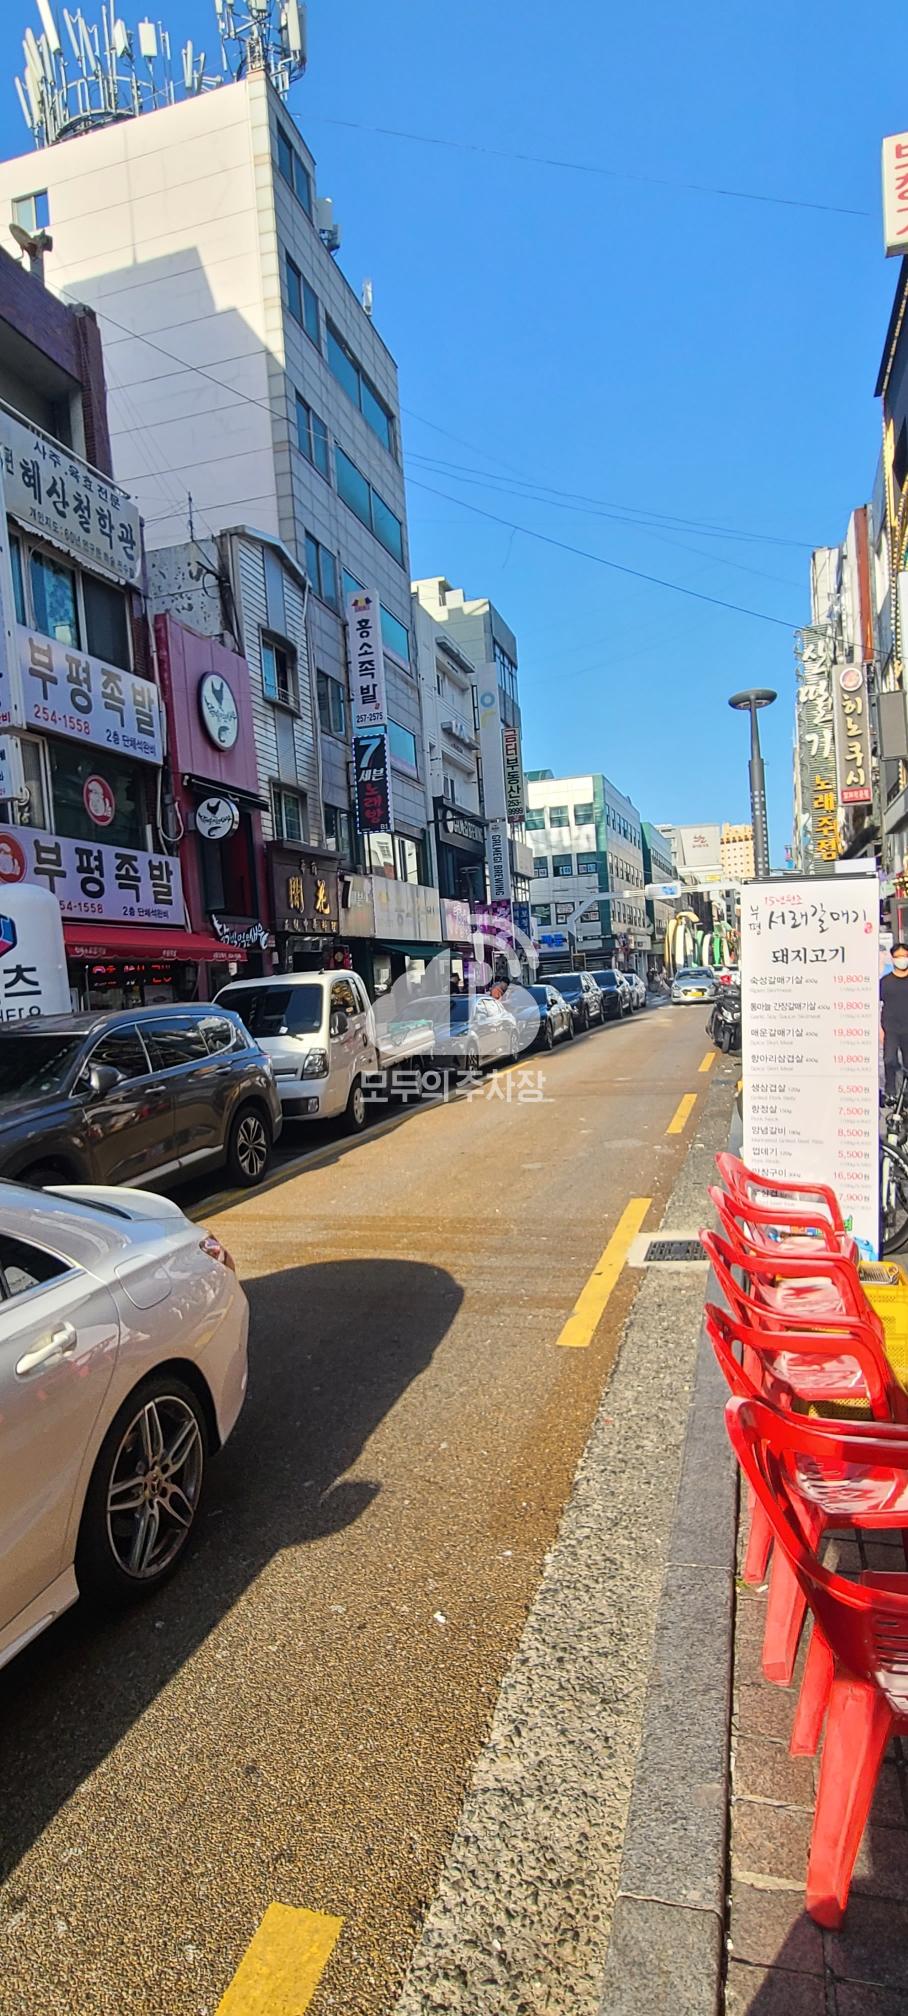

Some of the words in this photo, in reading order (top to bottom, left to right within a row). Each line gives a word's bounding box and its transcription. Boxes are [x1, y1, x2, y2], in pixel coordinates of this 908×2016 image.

[19, 458, 137, 562] 혜산철학관
[355, 618, 378, 705] 홍소족발
[28, 638, 155, 738] 부평족발
[33, 704, 91, 736] 254-1558
[356, 711, 384, 723] 257-2575
[105, 728, 120, 746] 2층
[842, 694, 865, 787] 히노쿠시
[359, 738, 382, 769] 7
[358, 768, 384, 783] 세븐
[362, 783, 385, 824] 노래방
[508, 807, 524, 816] 9999
[813, 774, 838, 861] 노래주점
[491, 834, 503, 864] GALMEGI
[34, 838, 174, 906] 부평족발
[493, 864, 505, 897] BREWING
[59, 900, 104, 914] 54-1558
[122, 905, 136, 917] 2층
[768, 902, 867, 934] 서래갈매기
[771, 946, 846, 965] 돼지고기
[3, 964, 42, 998] 츠
[750, 975, 803, 985] 숙성갈매기살
[751, 1083, 787, 1093] 생삼겹살
[751, 1104, 778, 1114] 항정살
[751, 1126, 786, 1136] 양념갈비
